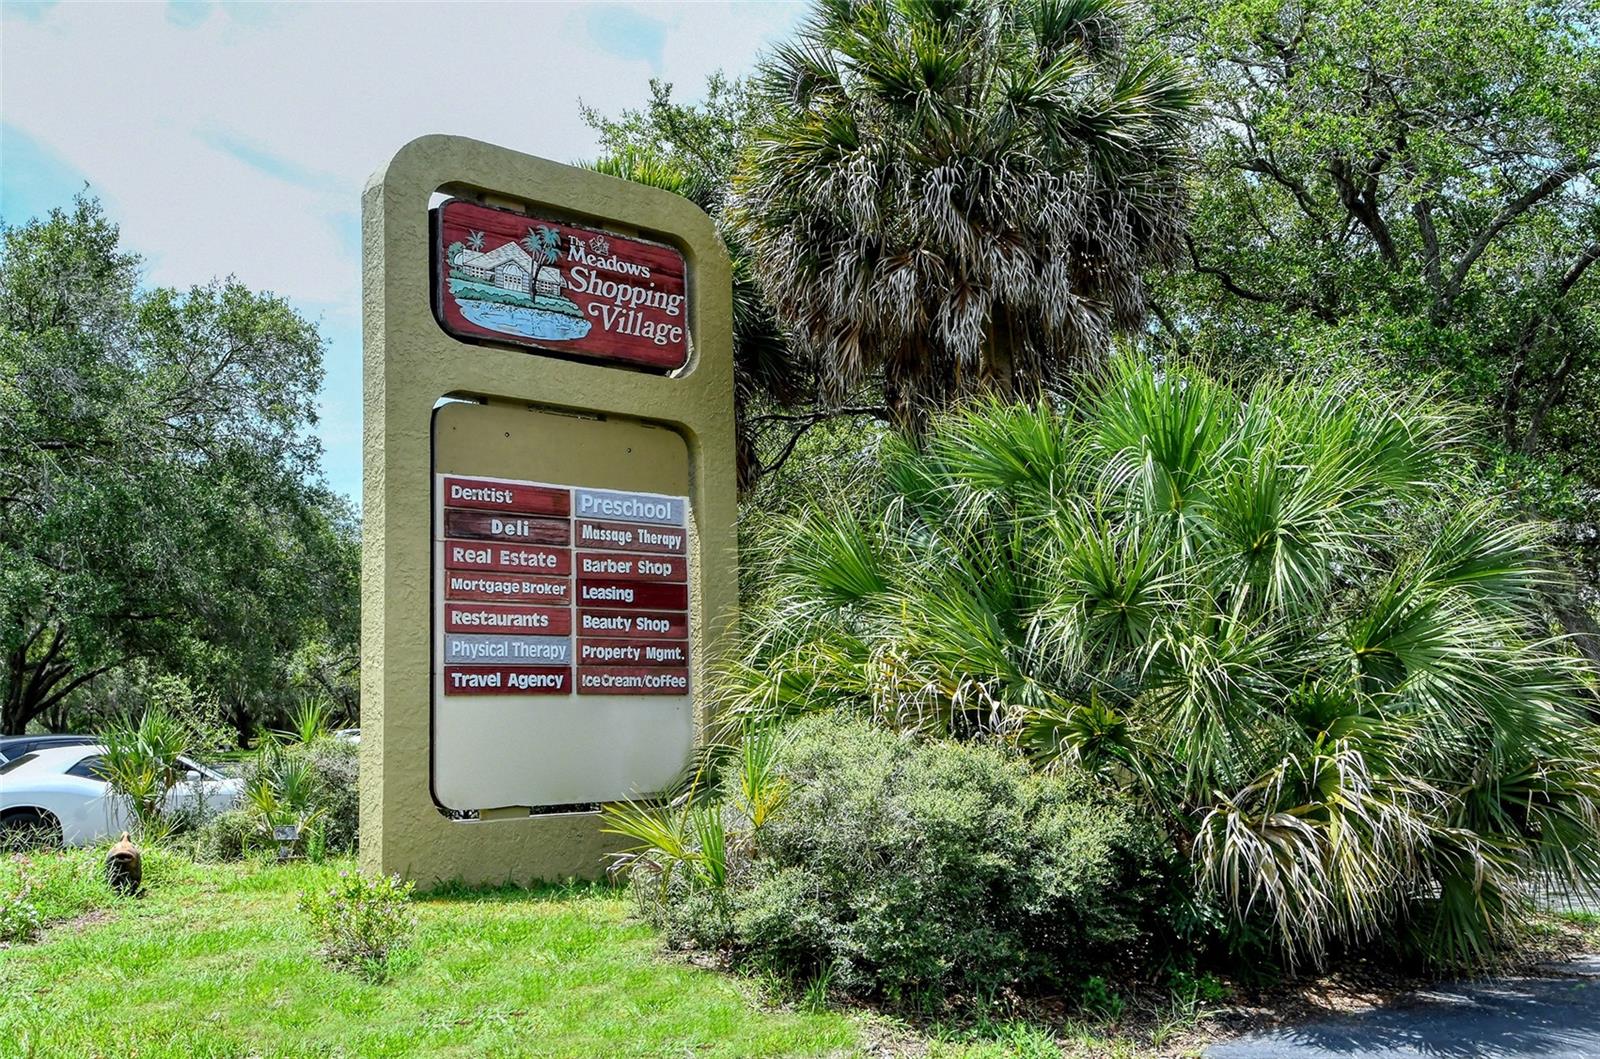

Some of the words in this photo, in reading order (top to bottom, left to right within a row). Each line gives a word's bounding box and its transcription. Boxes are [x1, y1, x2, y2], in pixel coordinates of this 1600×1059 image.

[567, 235, 587, 248] The
[567, 245, 651, 279] Meadows
[567, 266, 685, 317] Shopping
[588, 302, 683, 345] Village
[451, 485, 513, 504] Dentist
[581, 494, 671, 520] Preschool
[491, 518, 529, 537] Deli
[582, 524, 633, 546] Massage
[637, 528, 682, 550] Therapy
[453, 547, 492, 564] Real
[500, 549, 557, 568] Estate
[583, 558, 633, 574] Barber
[637, 560, 672, 577] Shop
[451, 578, 520, 595] Mortgage
[522, 581, 567, 595] Broker
[582, 585, 634, 603] Leasing
[451, 610, 549, 627] Restaurants
[582, 615, 632, 632] Beauty
[636, 616, 670, 633] Shop
[452, 640, 508, 659] Physical
[512, 641, 567, 660] Therapy
[582, 645, 641, 661] Property
[645, 646, 686, 662] Mgmt.
[451, 672, 501, 688] Travel
[507, 673, 564, 689] Agency
